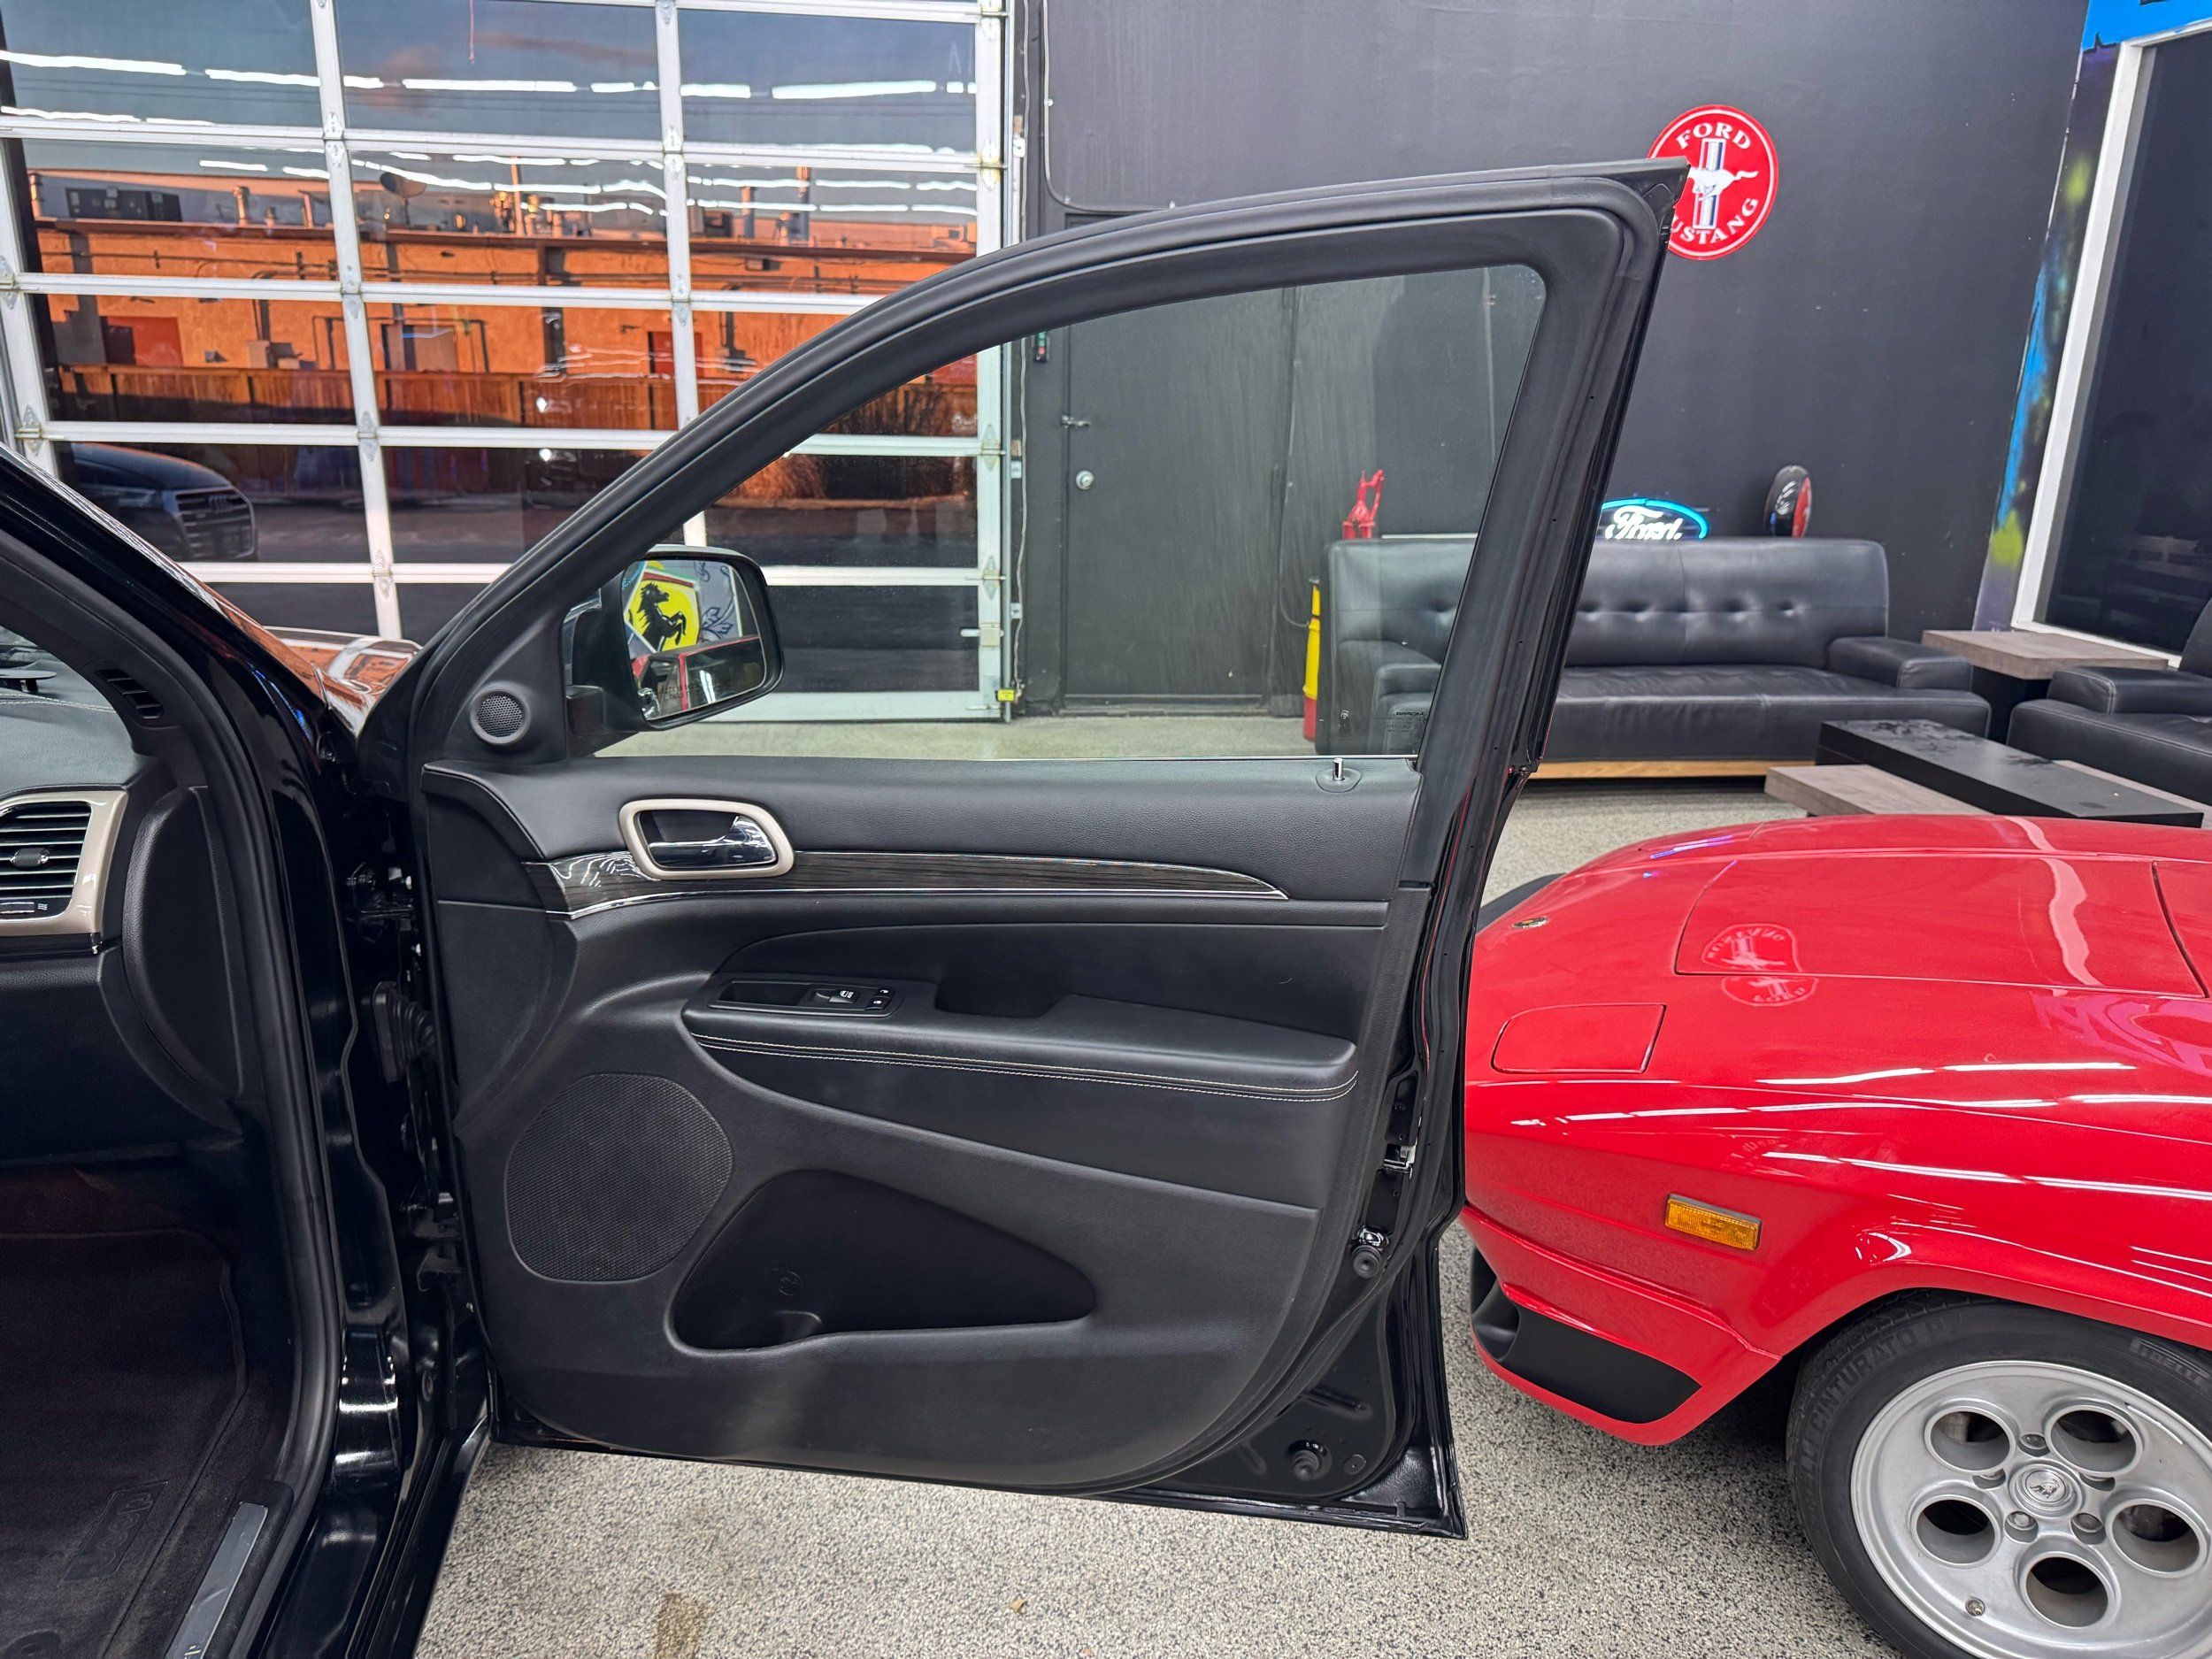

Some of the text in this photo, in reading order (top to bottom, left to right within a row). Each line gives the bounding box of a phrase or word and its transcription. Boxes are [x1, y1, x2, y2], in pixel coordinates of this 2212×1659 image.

[1676, 122, 1751, 150] FORD
[1671, 197, 1759, 244] USTANG
[1810, 1329, 1918, 1429] CINTURATO
